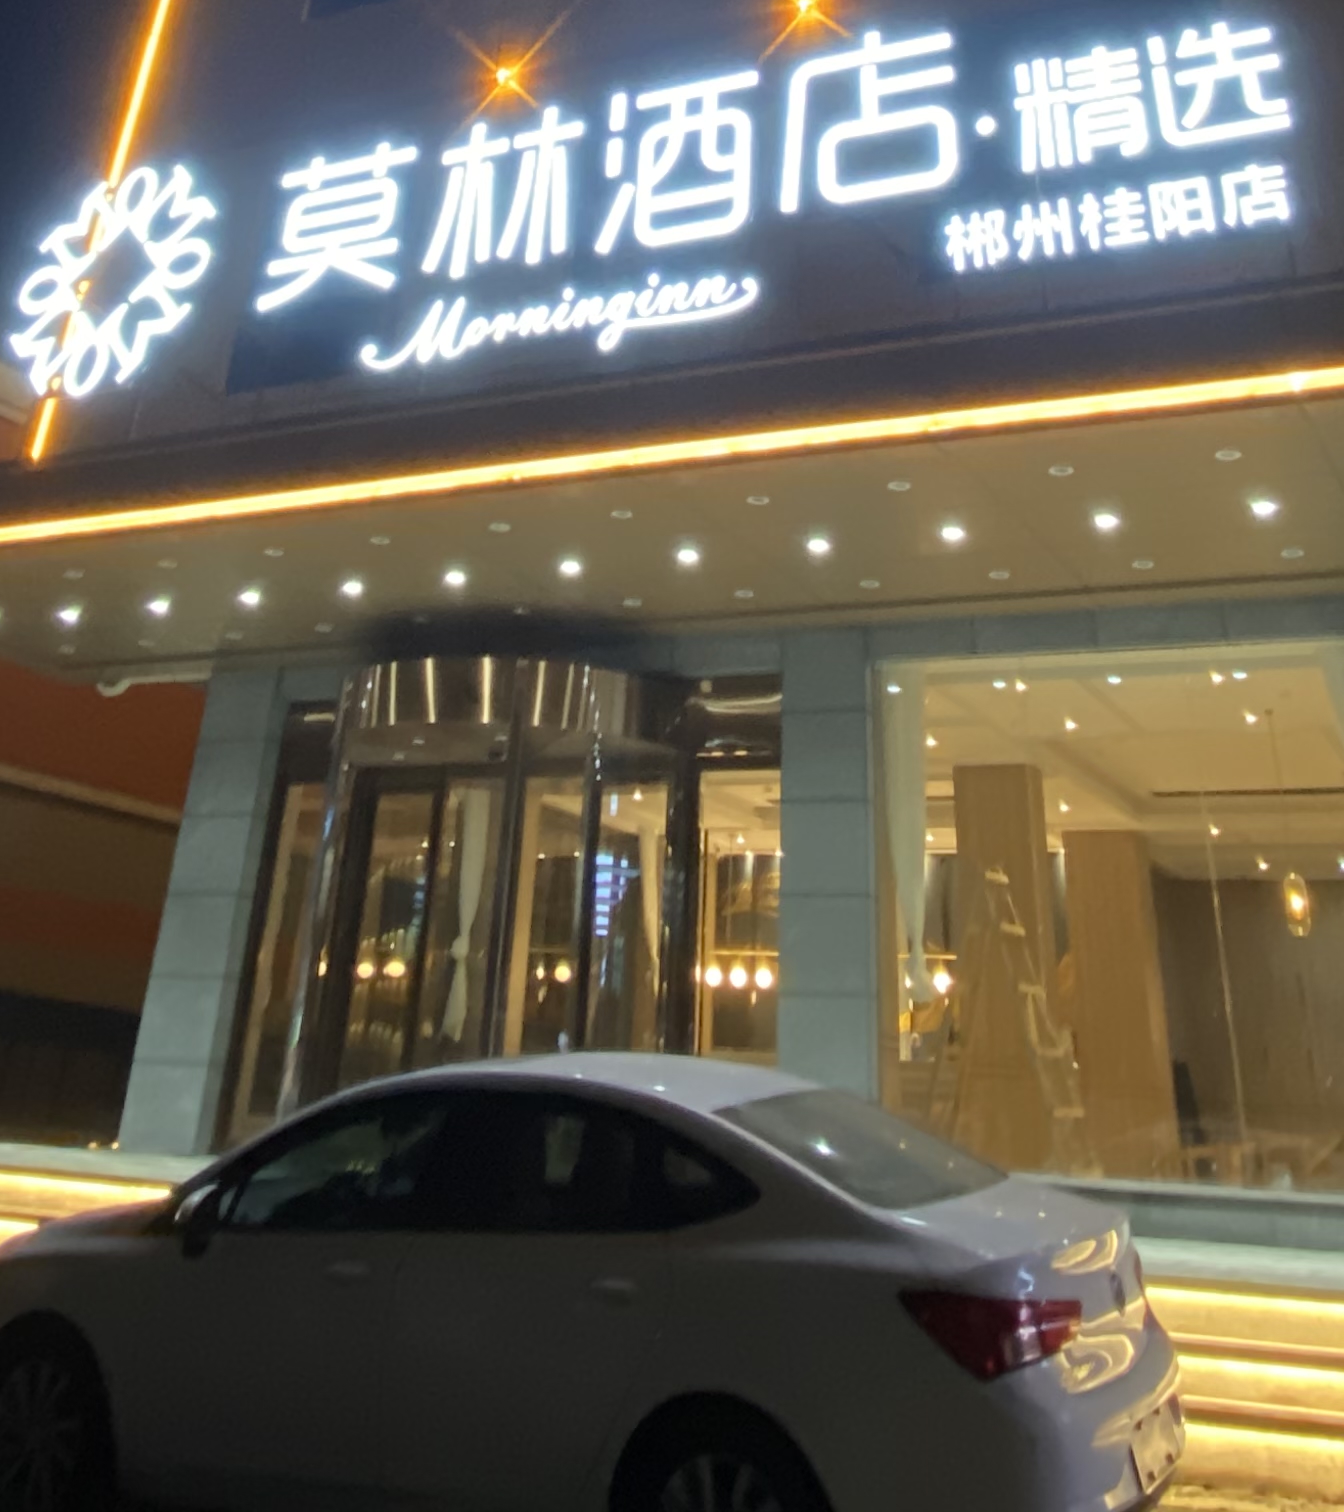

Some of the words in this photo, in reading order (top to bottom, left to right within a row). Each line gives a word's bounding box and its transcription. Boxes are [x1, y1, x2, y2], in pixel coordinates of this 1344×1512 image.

[944, 163, 1291, 272] 郴州桂阳店
[360, 273, 758, 370] Morninginn
